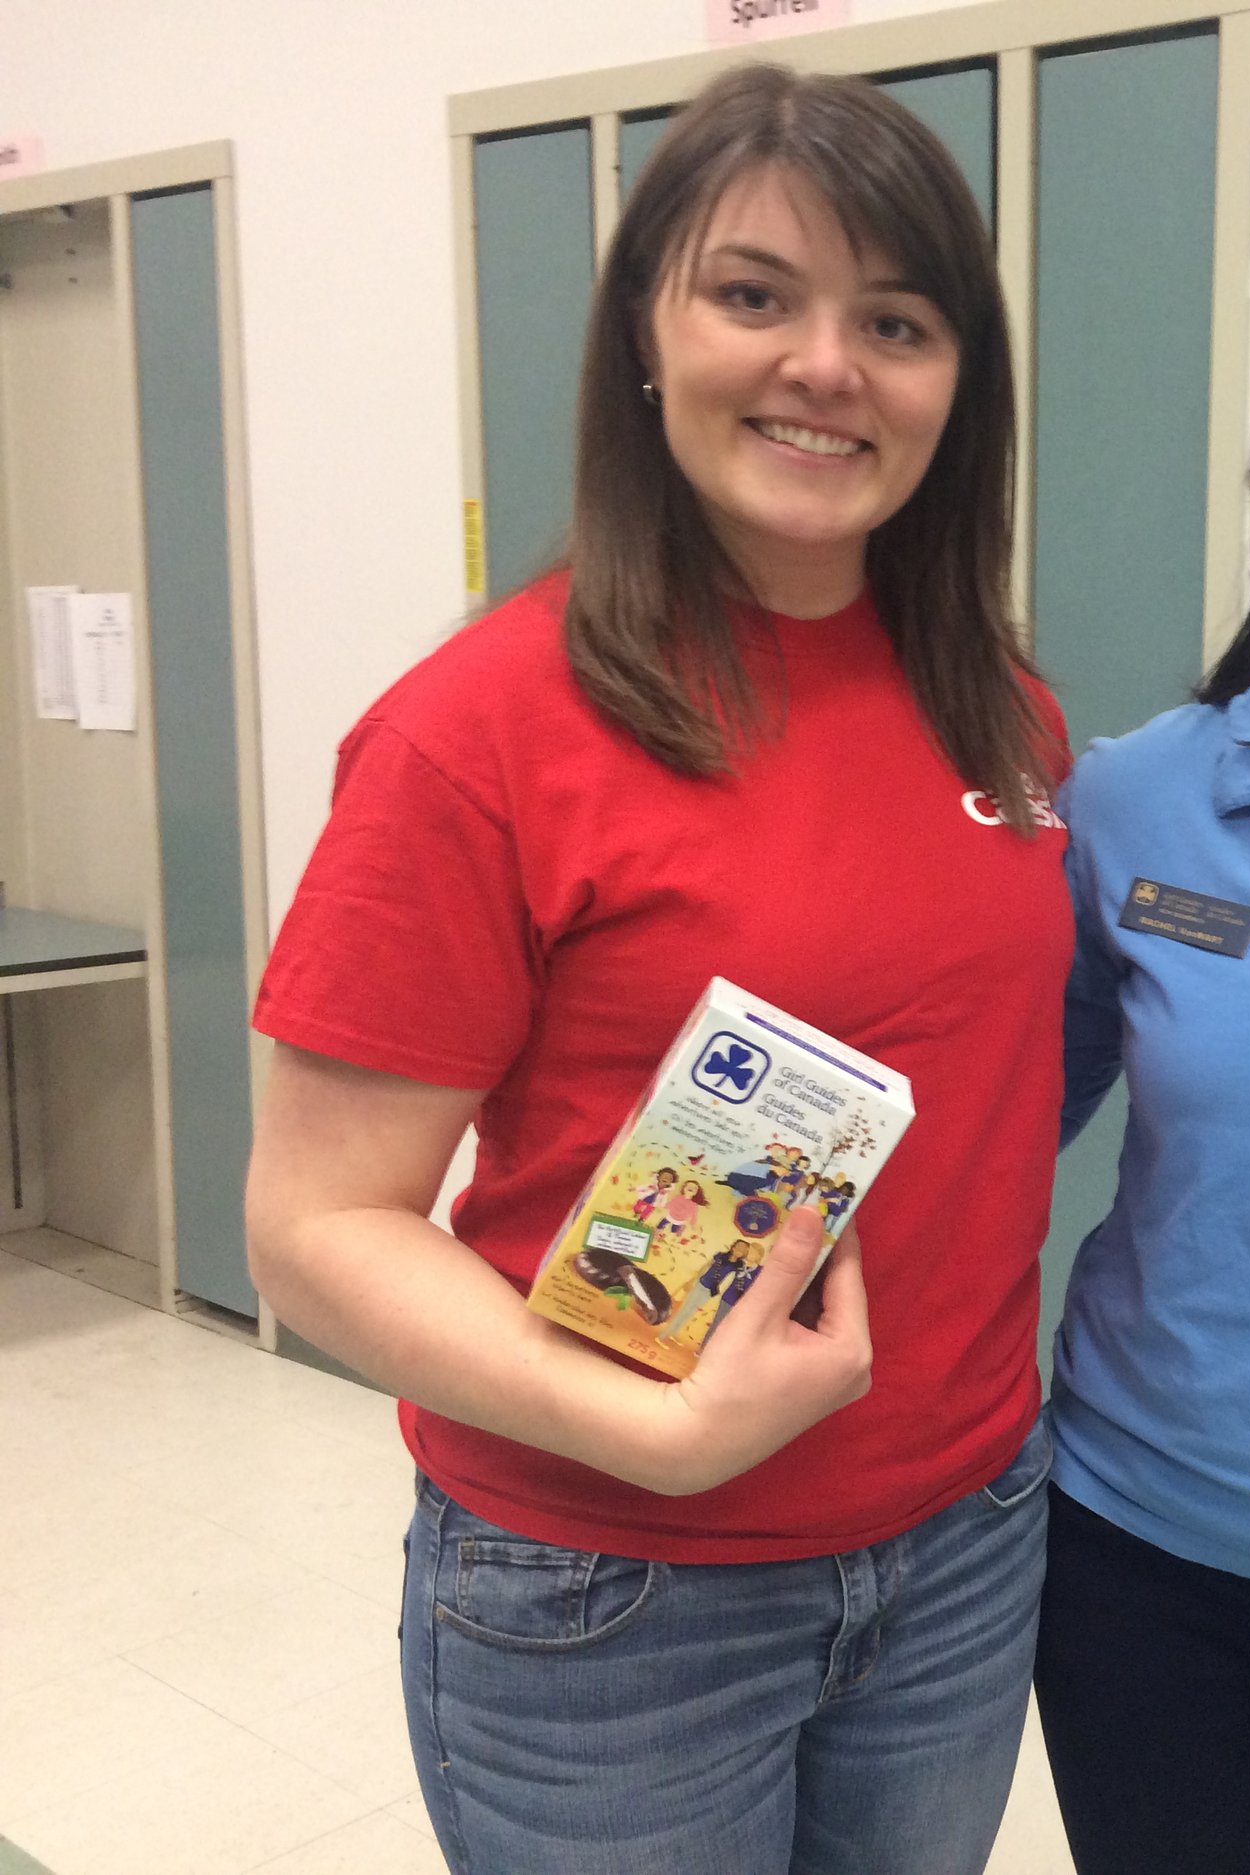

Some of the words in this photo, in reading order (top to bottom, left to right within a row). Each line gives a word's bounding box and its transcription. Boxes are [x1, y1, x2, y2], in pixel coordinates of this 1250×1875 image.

[773, 1078, 790, 1090] of
[788, 1085, 836, 1116] Canada
[780, 1066, 805, 1084] Girl
[805, 1079, 847, 1107] Guides
[757, 1103, 774, 1118] du
[775, 1113, 823, 1144] Canada
[763, 1093, 806, 1121] Guides
